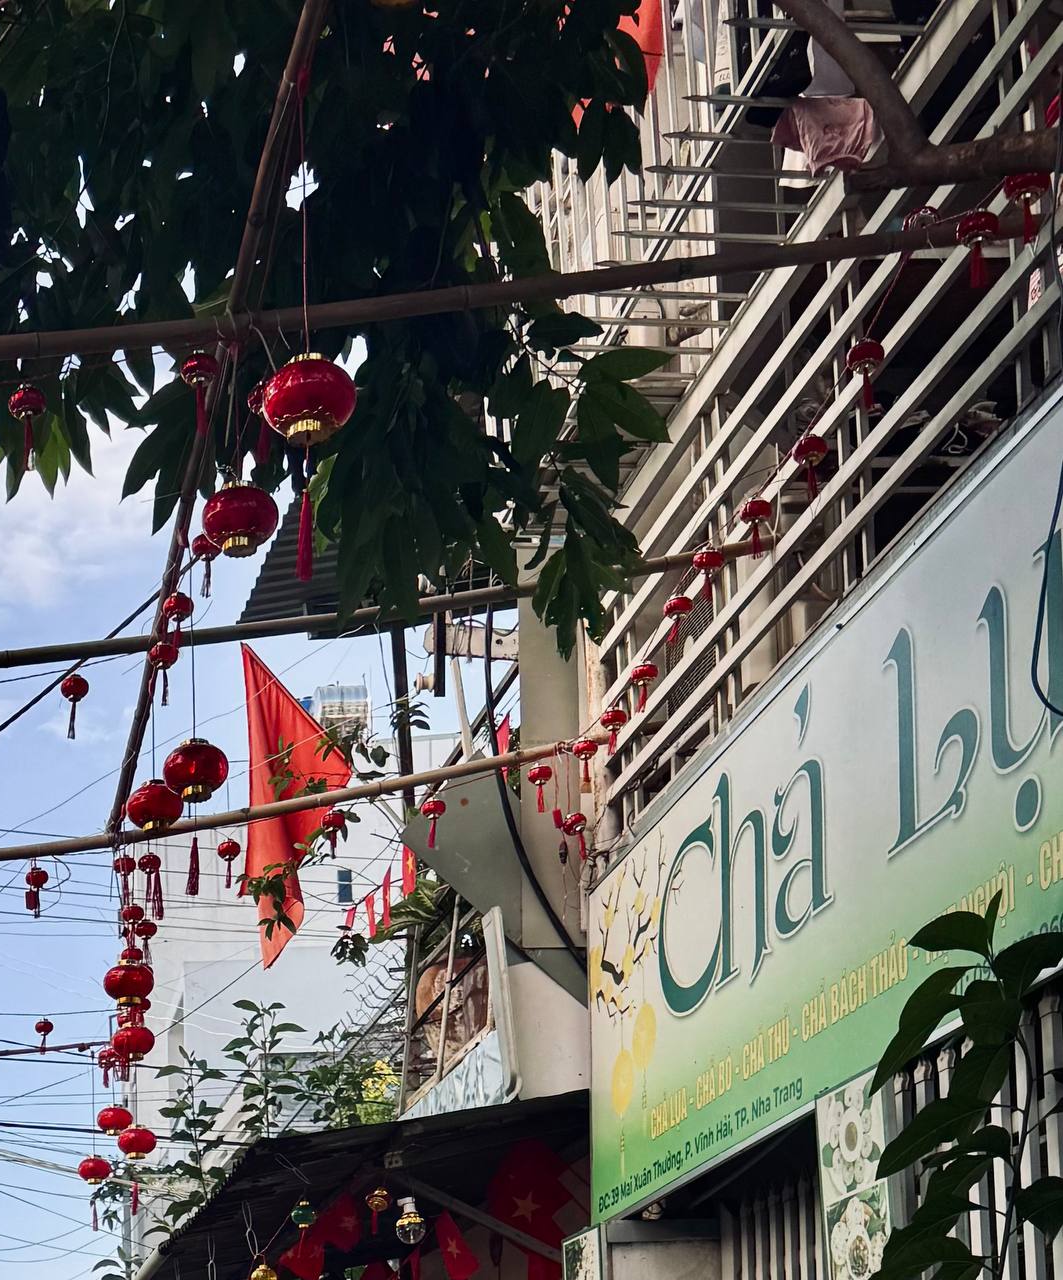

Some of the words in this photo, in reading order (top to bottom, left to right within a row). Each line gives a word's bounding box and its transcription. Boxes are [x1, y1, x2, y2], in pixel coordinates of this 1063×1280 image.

[658, 680, 834, 1017] Chả
[801, 977, 828, 1042] CHẢ
[830, 967, 868, 1026] BÁCH
[620, 1175, 633, 1201] Mai
[634, 1167, 651, 1192] Xuân
[685, 1140, 693, 1160] P.
[735, 1106, 749, 1131] TP.
[751, 1097, 771, 1122] Nha
[773, 1077, 803, 1108] Trang
